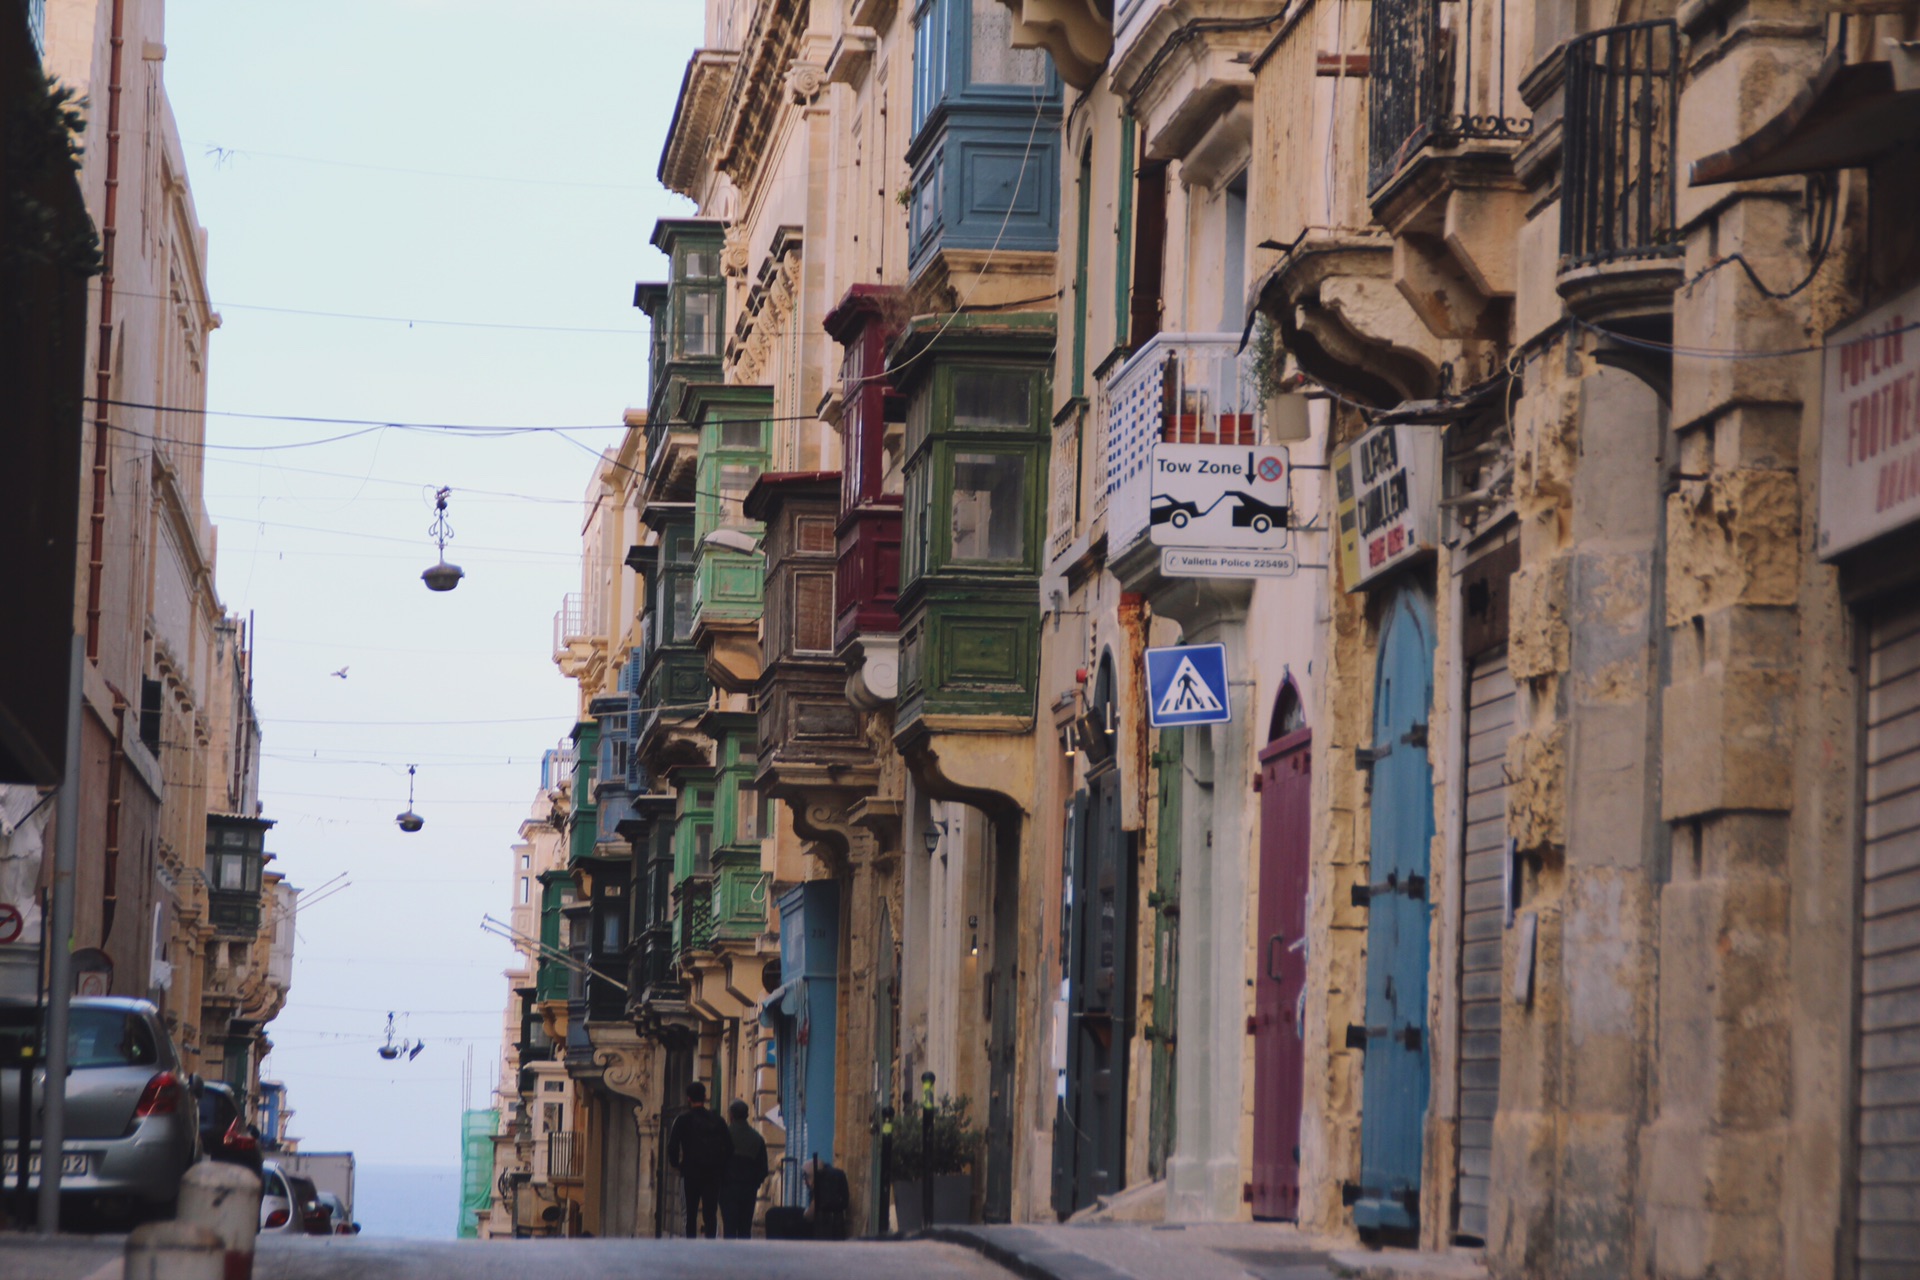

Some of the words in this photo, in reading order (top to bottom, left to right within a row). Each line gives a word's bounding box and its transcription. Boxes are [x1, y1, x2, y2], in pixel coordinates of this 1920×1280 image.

[1157, 458, 1192, 473] Tow
[1197, 459, 1243, 475] Zone
[1181, 556, 1218, 567] Valletta
[1220, 558, 1251, 568] Police
[1254, 559, 1289, 569] 225495
